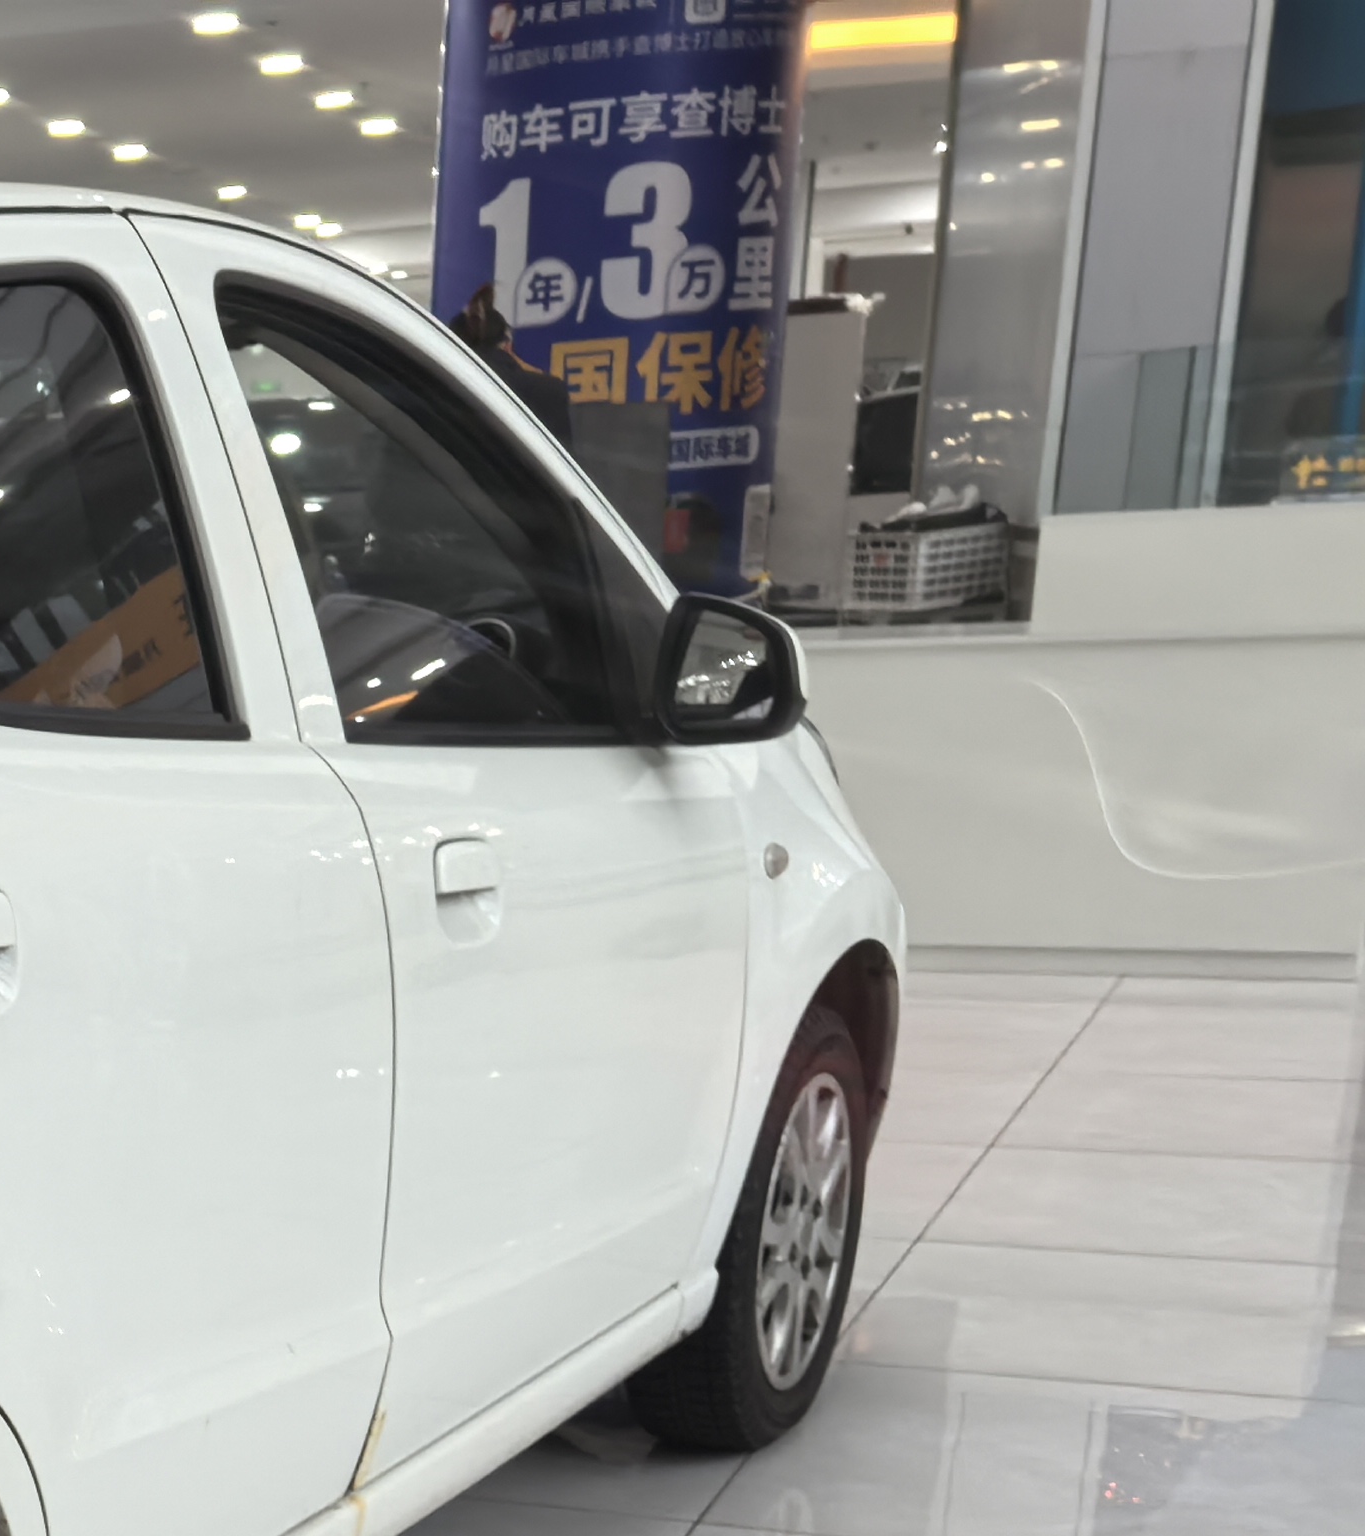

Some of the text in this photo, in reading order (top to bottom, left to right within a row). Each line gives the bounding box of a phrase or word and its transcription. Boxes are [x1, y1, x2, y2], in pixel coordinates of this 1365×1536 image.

[480, 84, 787, 162] 购车可享查博士
